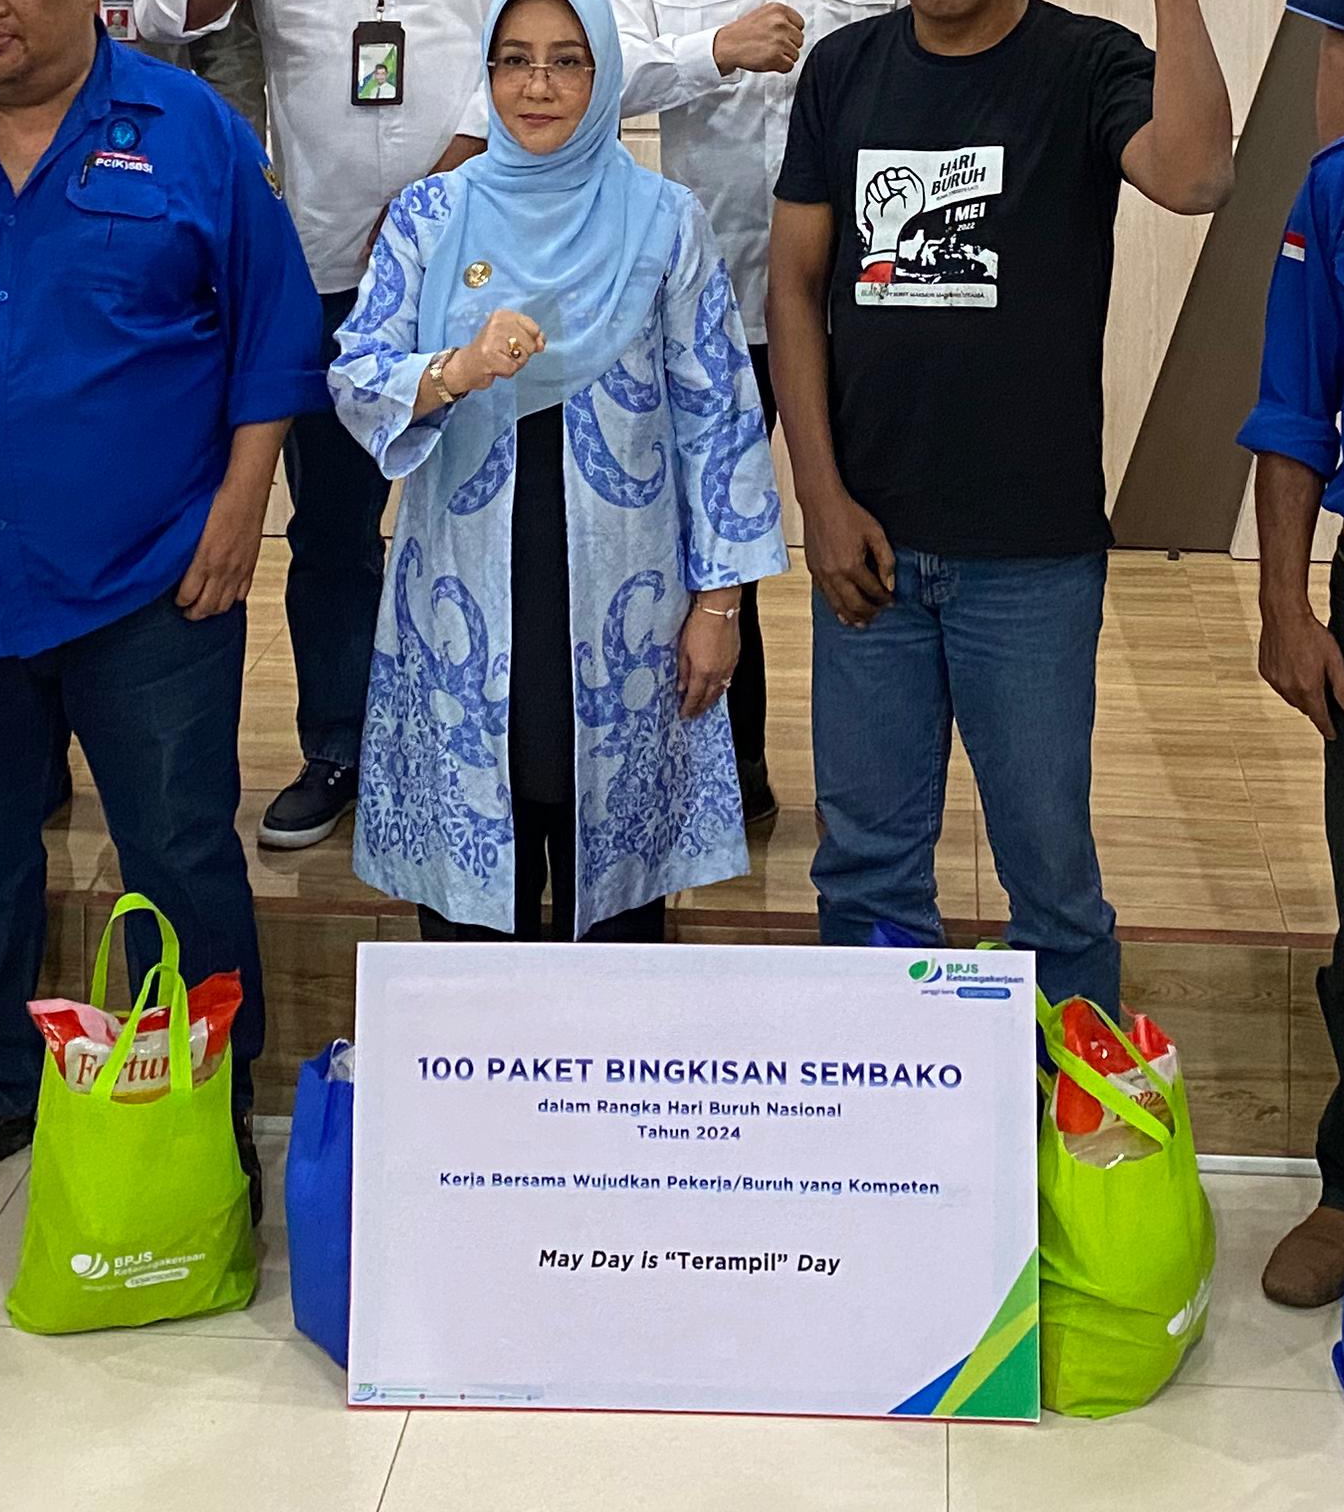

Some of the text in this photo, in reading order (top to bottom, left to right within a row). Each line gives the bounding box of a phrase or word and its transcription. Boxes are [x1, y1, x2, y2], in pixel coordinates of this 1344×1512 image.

[939, 152, 976, 178] HARI
[931, 166, 987, 196] BURUH
[945, 202, 987, 225] 1 MEI
[946, 963, 979, 974] BPJS
[417, 1056, 962, 1088] 100 PAKET BINGKISAN SEMBAKO
[537, 1098, 842, 1118] dalam Rangka Hari Buruh Nasional
[636, 1124, 741, 1140] Tahun 2024
[439, 1171, 940, 1196] Kerja Bersama Wujudkan Pekerja/Buruh yang Kompeten
[114, 1251, 153, 1268] BPJS
[538, 1249, 584, 1272] May
[590, 1250, 635, 1272] Day
[641, 1250, 659, 1269] is
[797, 1254, 841, 1276] Day
